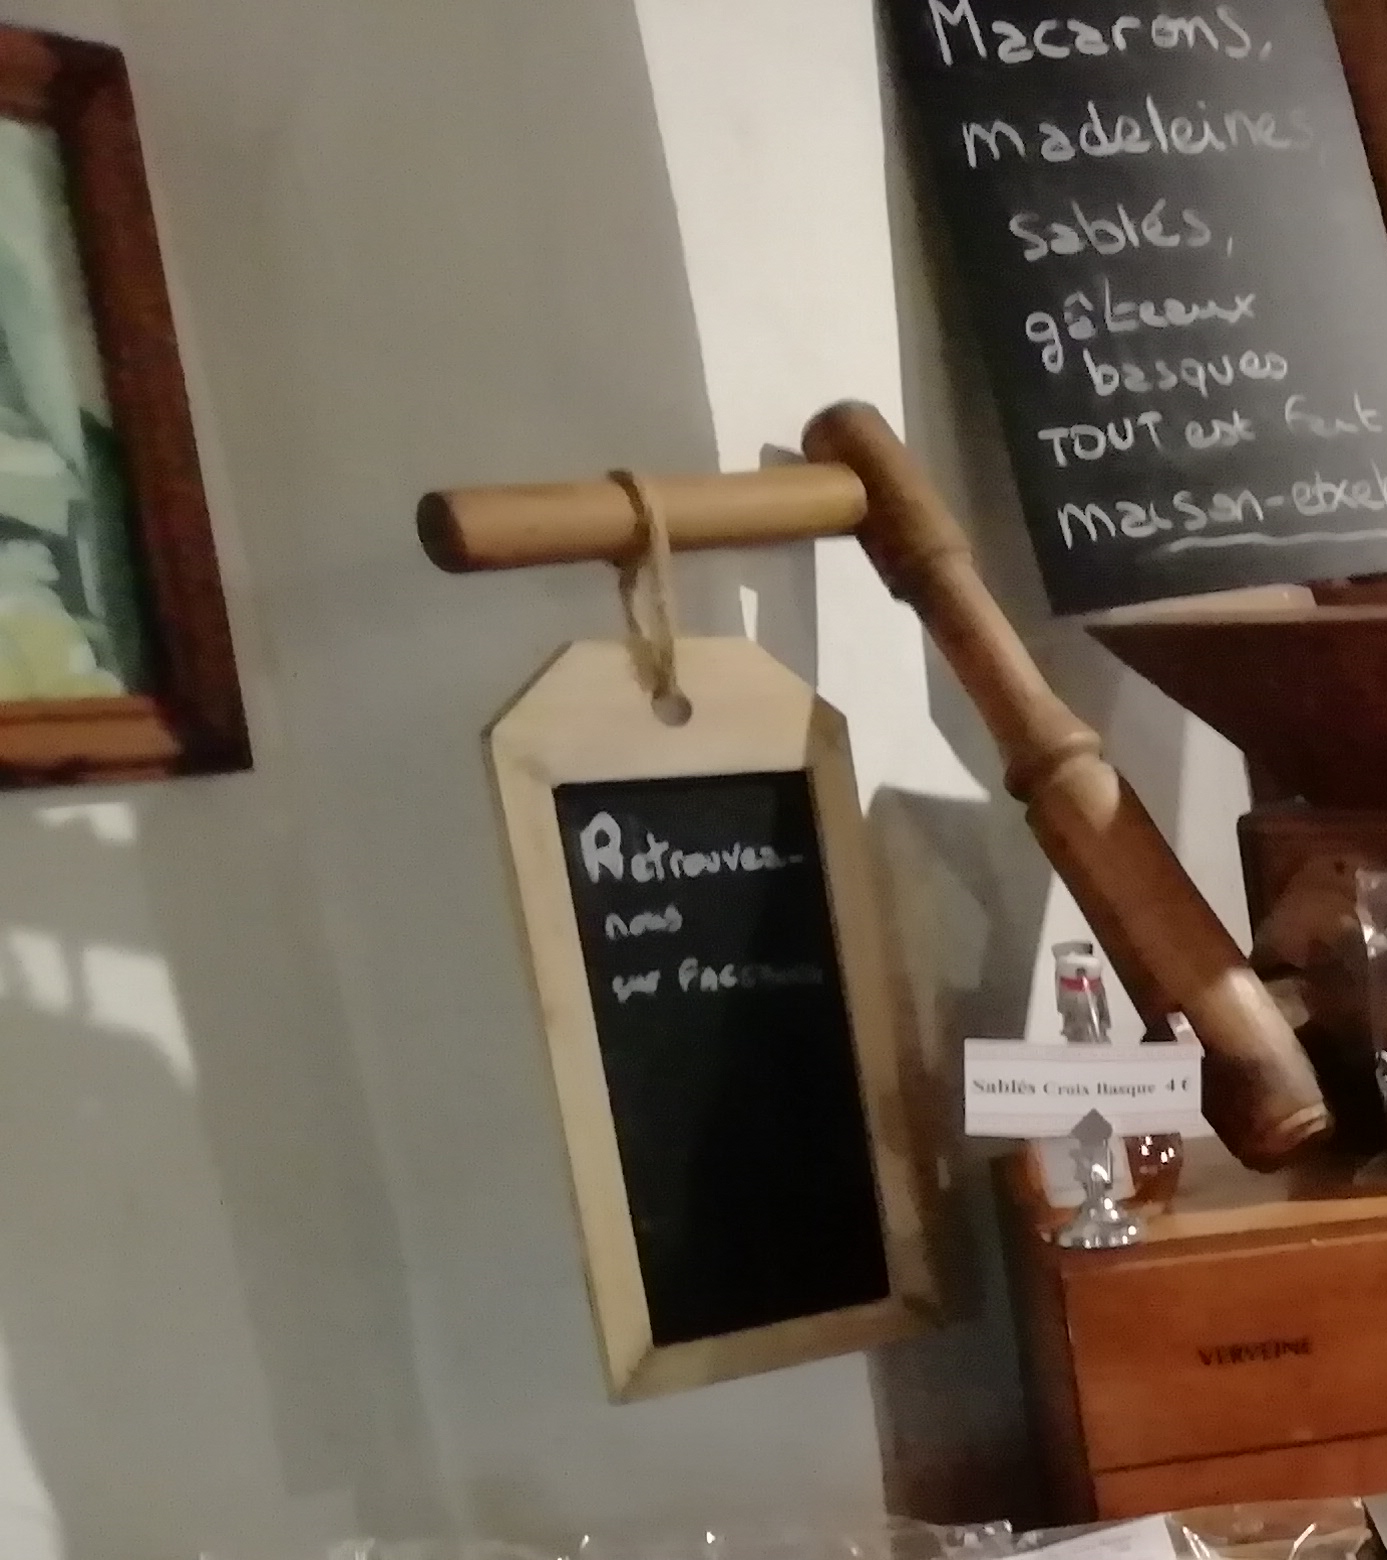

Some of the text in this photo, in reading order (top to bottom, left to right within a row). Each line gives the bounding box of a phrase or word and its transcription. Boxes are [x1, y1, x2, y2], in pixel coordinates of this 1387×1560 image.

[1037, 410, 1166, 467] TOUT
[973, 1079, 1036, 1096] Sablés
[1043, 1080, 1090, 1096] Croix
[1097, 1080, 1156, 1098] Basque
